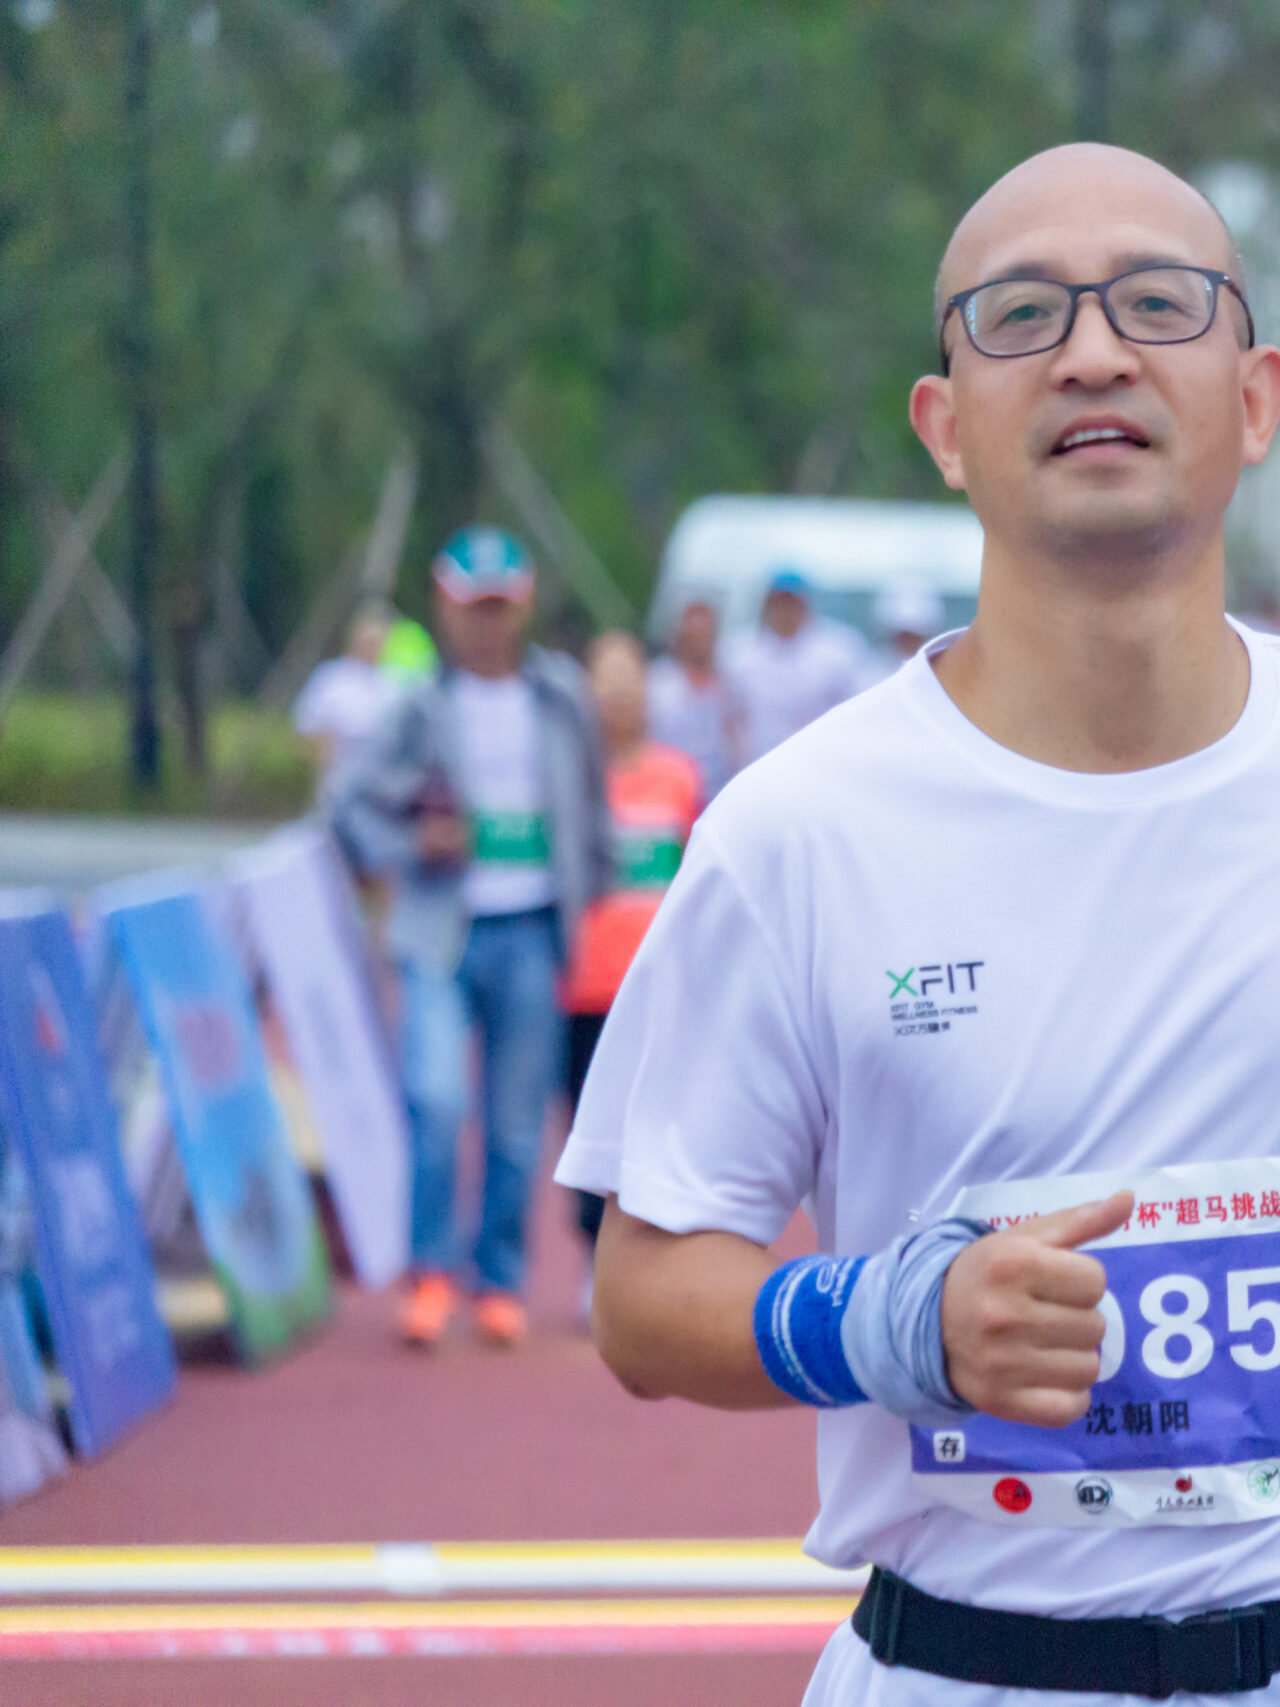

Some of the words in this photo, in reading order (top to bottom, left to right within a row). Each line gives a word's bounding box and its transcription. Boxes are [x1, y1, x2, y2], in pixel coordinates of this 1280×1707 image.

[886, 961, 984, 999] XFIT
[1085, 1402, 1189, 1435] 沈朝阳
[939, 1436, 960, 1457] 存
